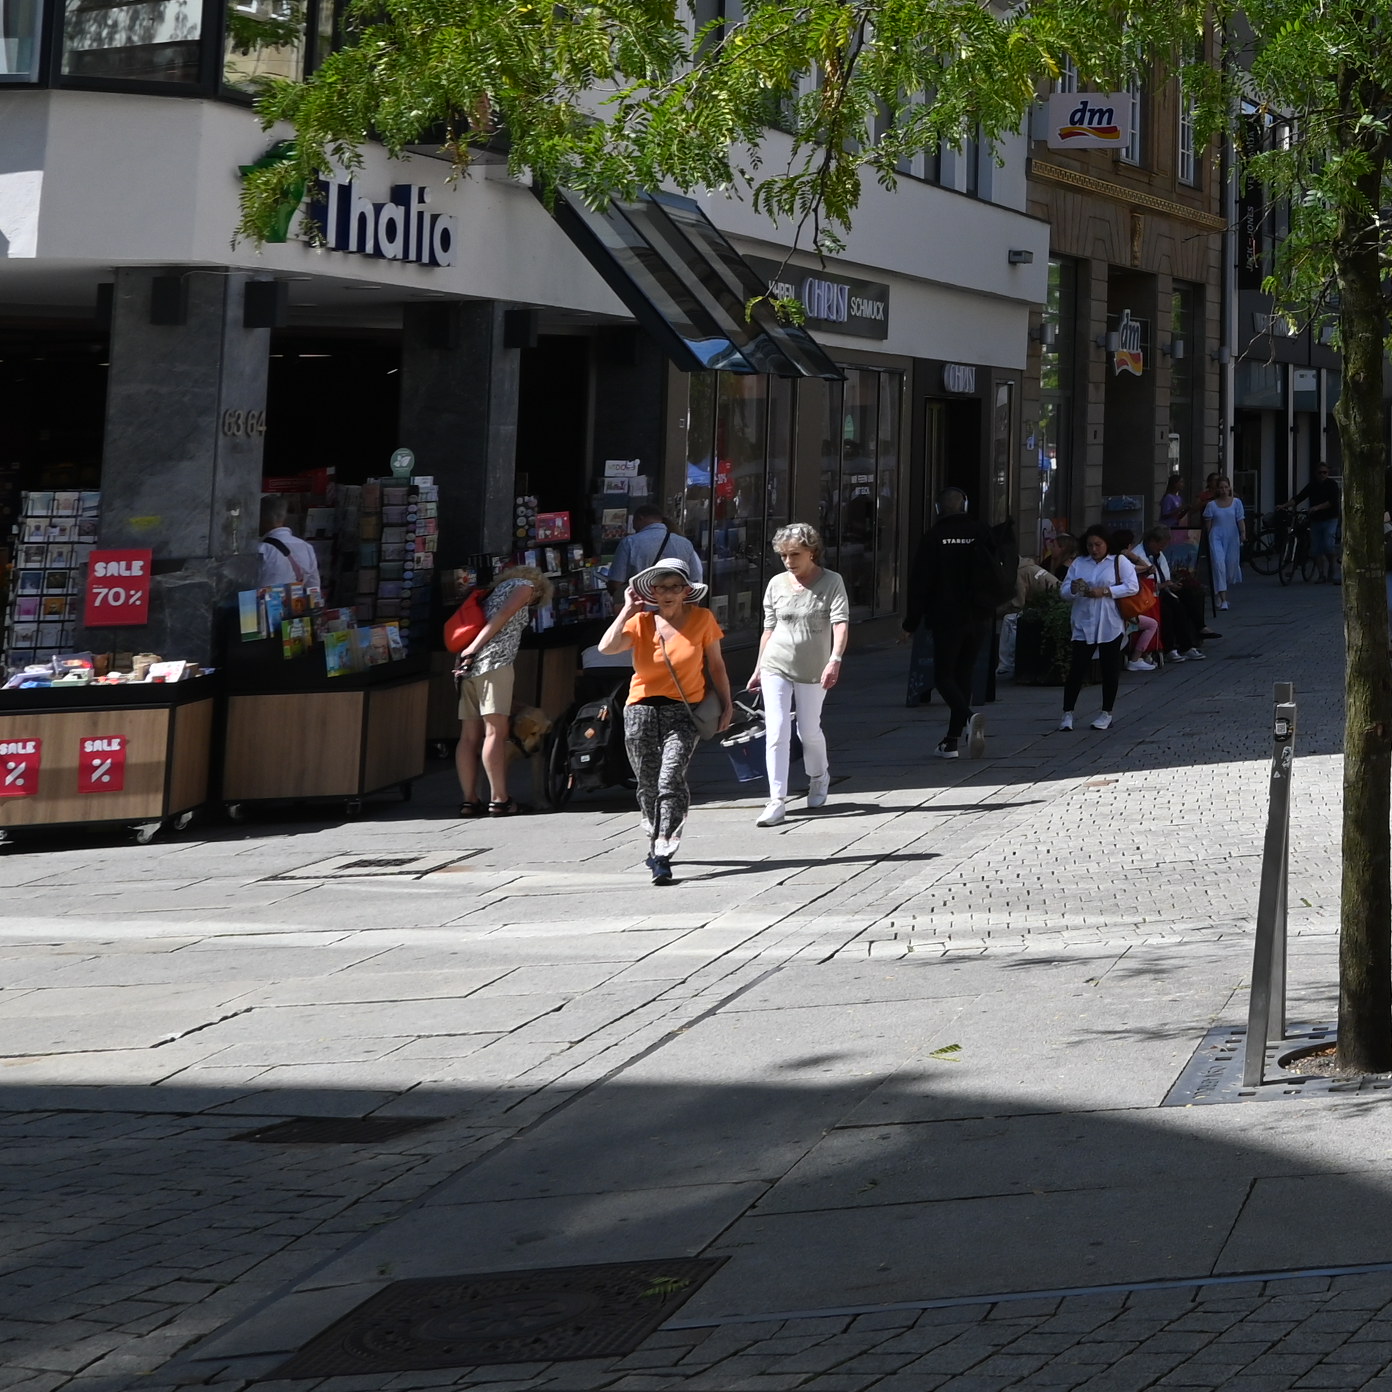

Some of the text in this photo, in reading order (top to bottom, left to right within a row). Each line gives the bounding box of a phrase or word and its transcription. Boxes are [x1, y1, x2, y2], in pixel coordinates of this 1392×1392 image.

[1069, 100, 1114, 126] dm
[316, 170, 458, 267] Thalia
[804, 277, 851, 322] CHRIST
[850, 296, 885, 321] SCHMUCK
[223, 408, 268, 437] 63 64
[93, 560, 144, 578] SALE
[0, 741, 36, 756] SALE
[84, 738, 121, 752] SALE
[5, 761, 26, 787] %
[91, 758, 112, 784] %
